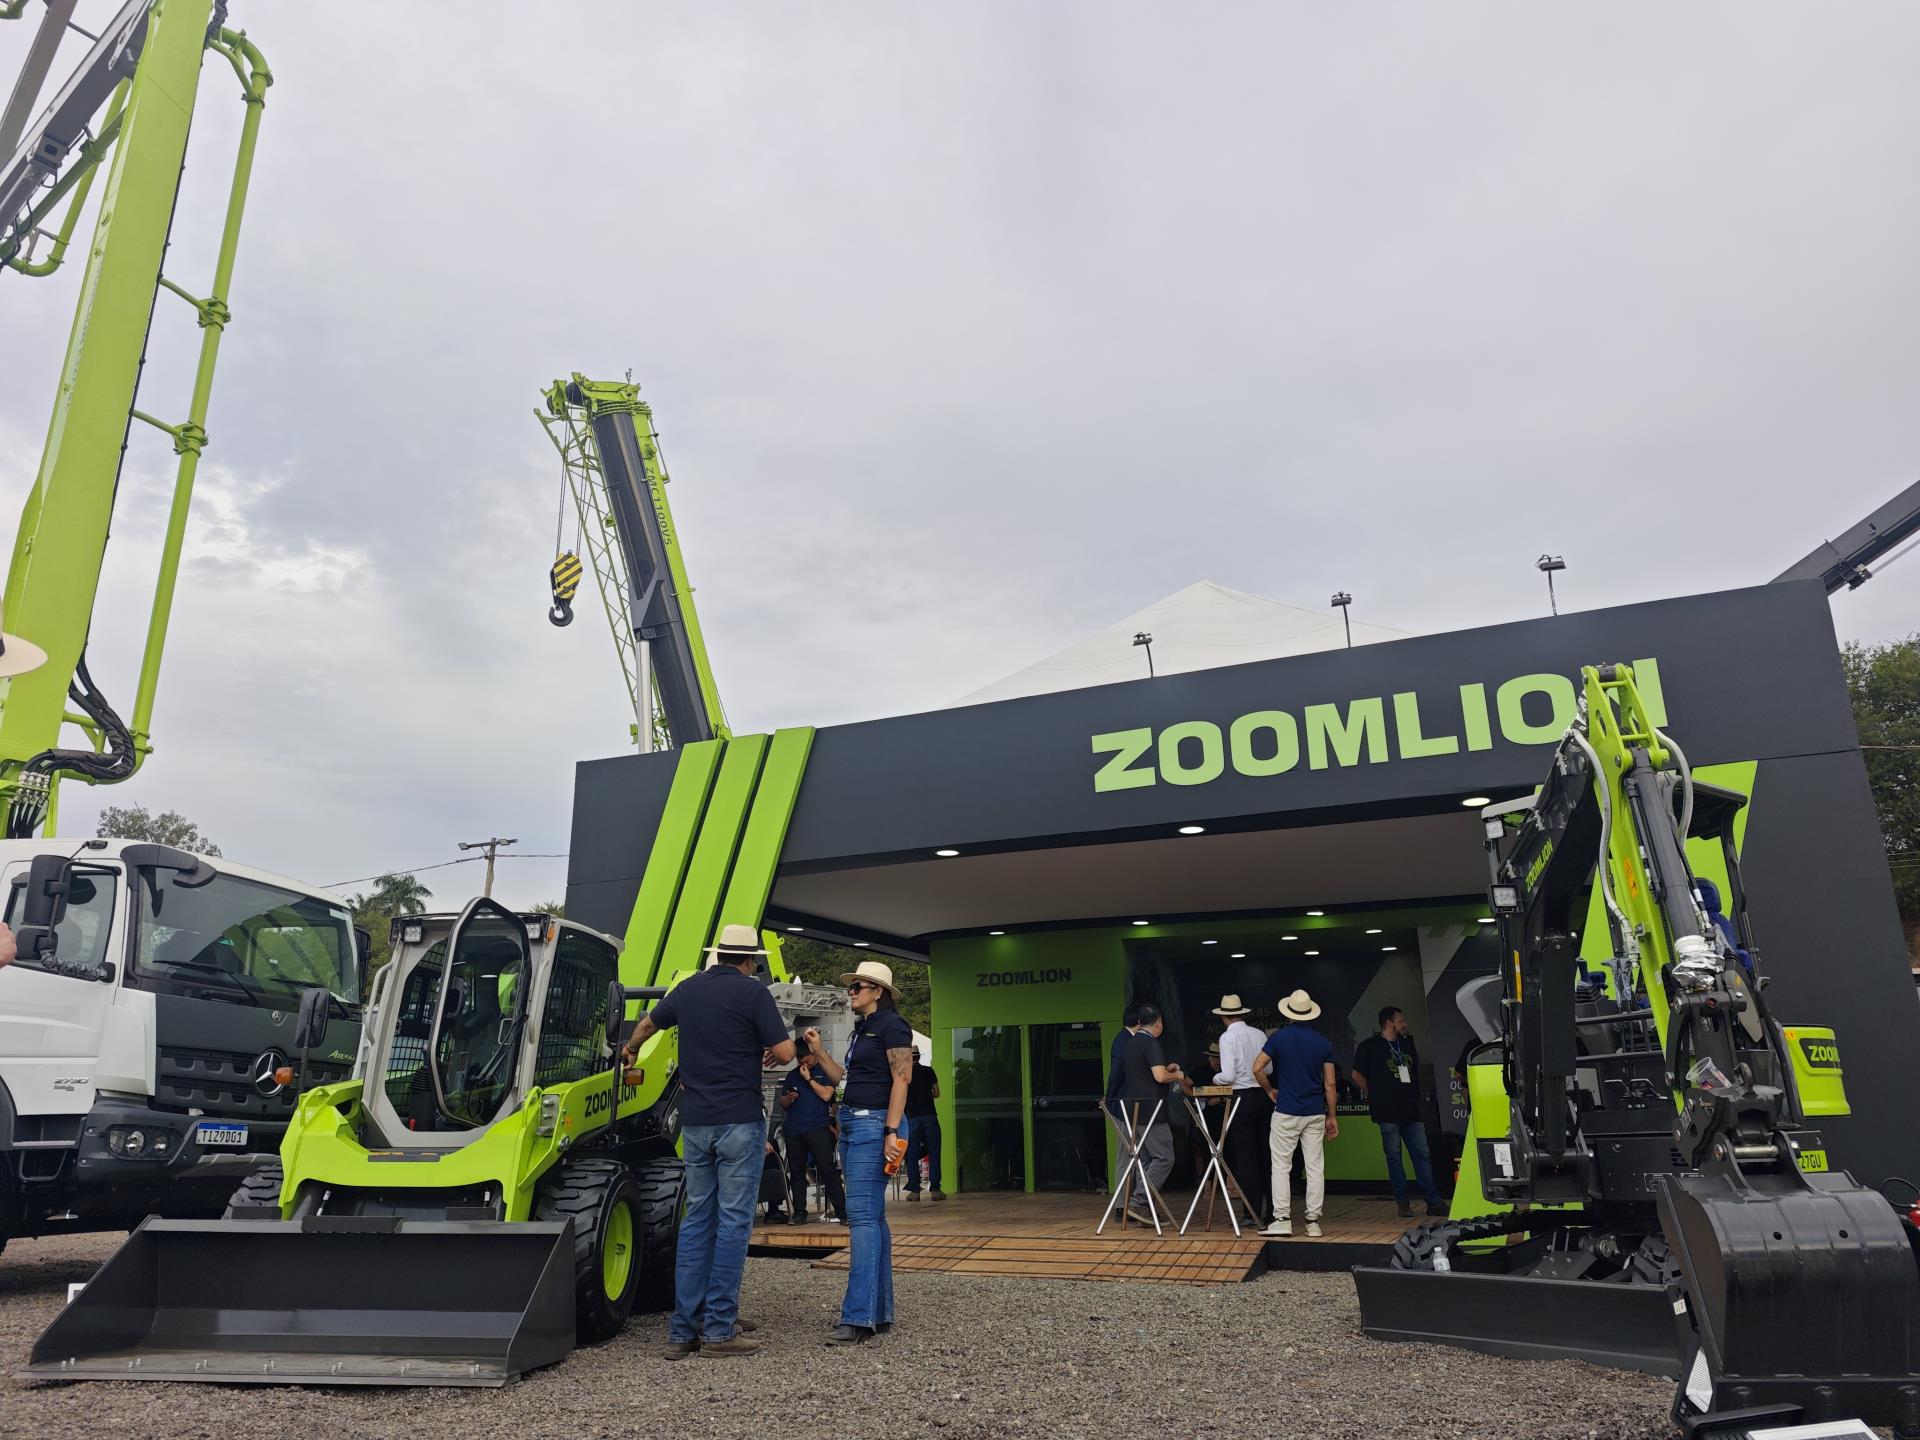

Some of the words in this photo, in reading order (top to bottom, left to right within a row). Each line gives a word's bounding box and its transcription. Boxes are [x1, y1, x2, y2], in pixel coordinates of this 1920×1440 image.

[1526, 836, 1553, 893] ZOOMLION
[976, 968, 1071, 987] ZOOMLION
[584, 1083, 637, 1118] ZOOION
[1796, 1154, 1822, 1169] 27GU
